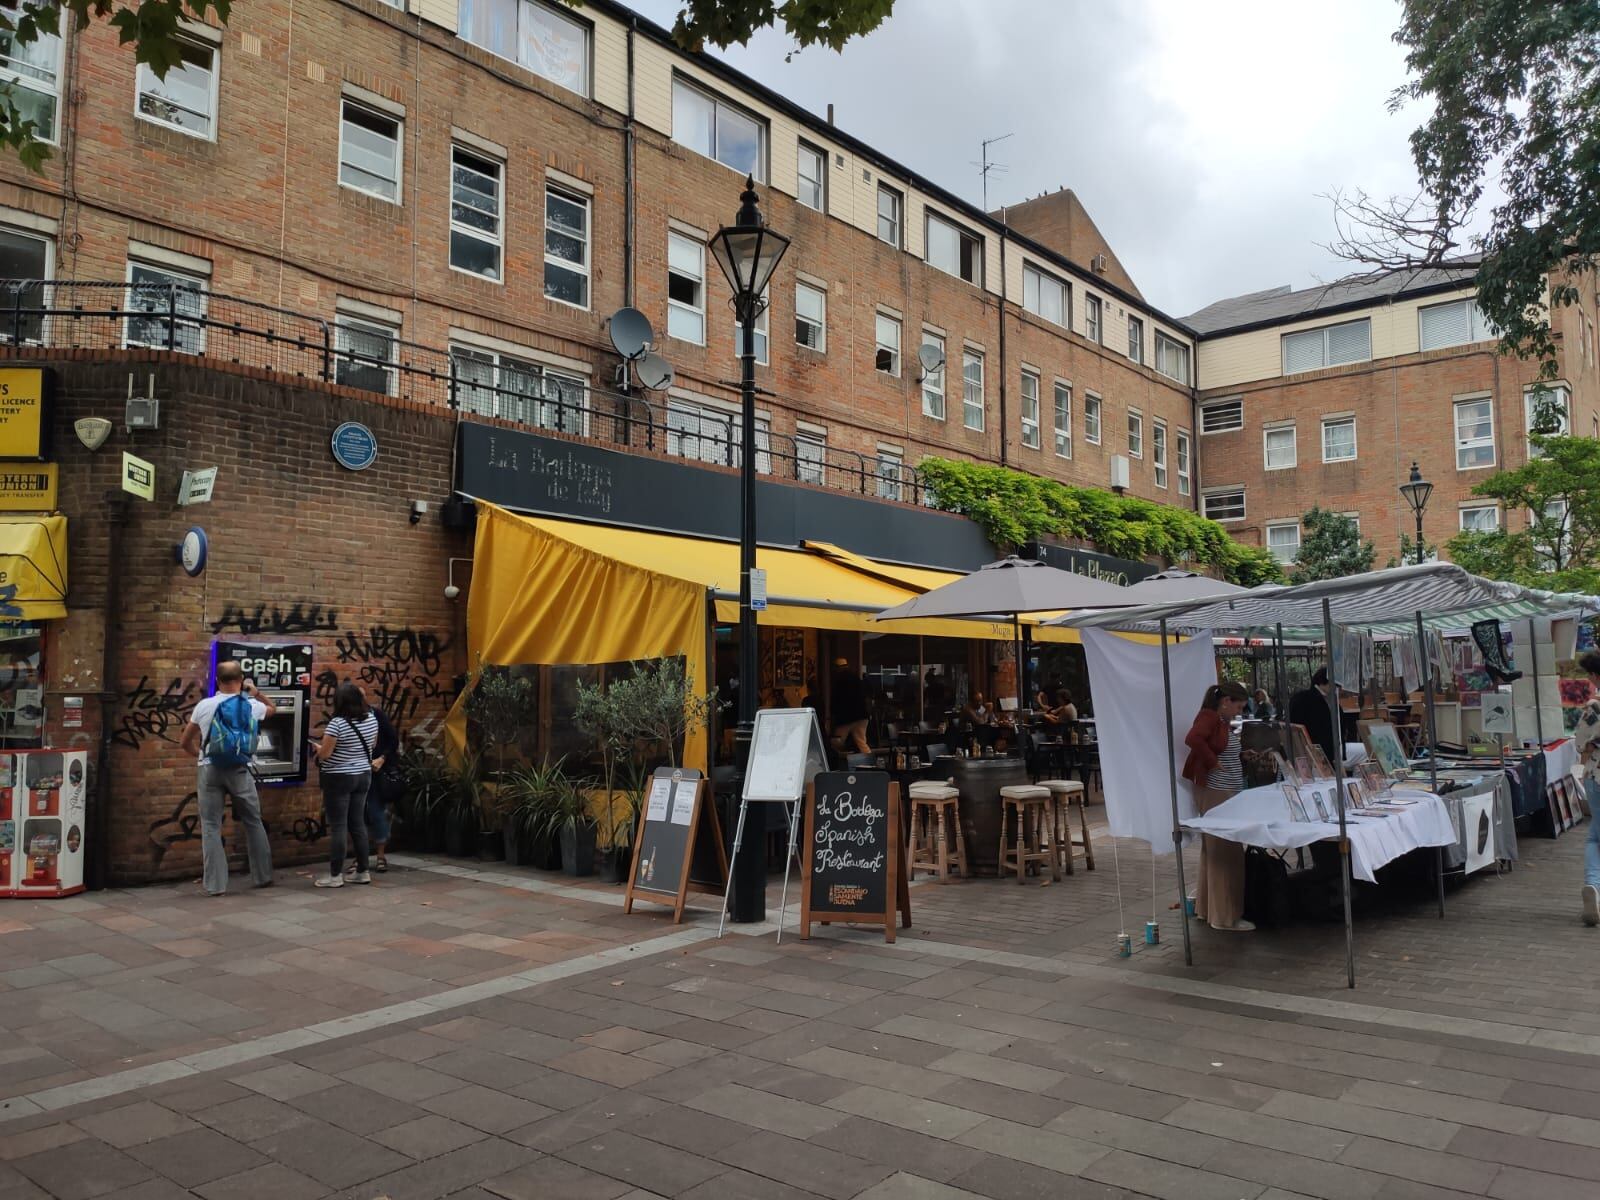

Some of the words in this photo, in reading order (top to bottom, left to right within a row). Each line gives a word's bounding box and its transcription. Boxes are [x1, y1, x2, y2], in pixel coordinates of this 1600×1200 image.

[2, 398, 36, 406] LICENCE
[0, 482, 37, 490] UNION
[1040, 546, 1047, 557] 74
[1071, 555, 1085, 577] La
[991, 624, 1011, 638] Muga
[240, 653, 292, 673] cash
[817, 794, 831, 815] La
[833, 791, 885, 825] Bodega
[815, 820, 875, 849] Spanish
[815, 848, 884, 873] Restaurant
